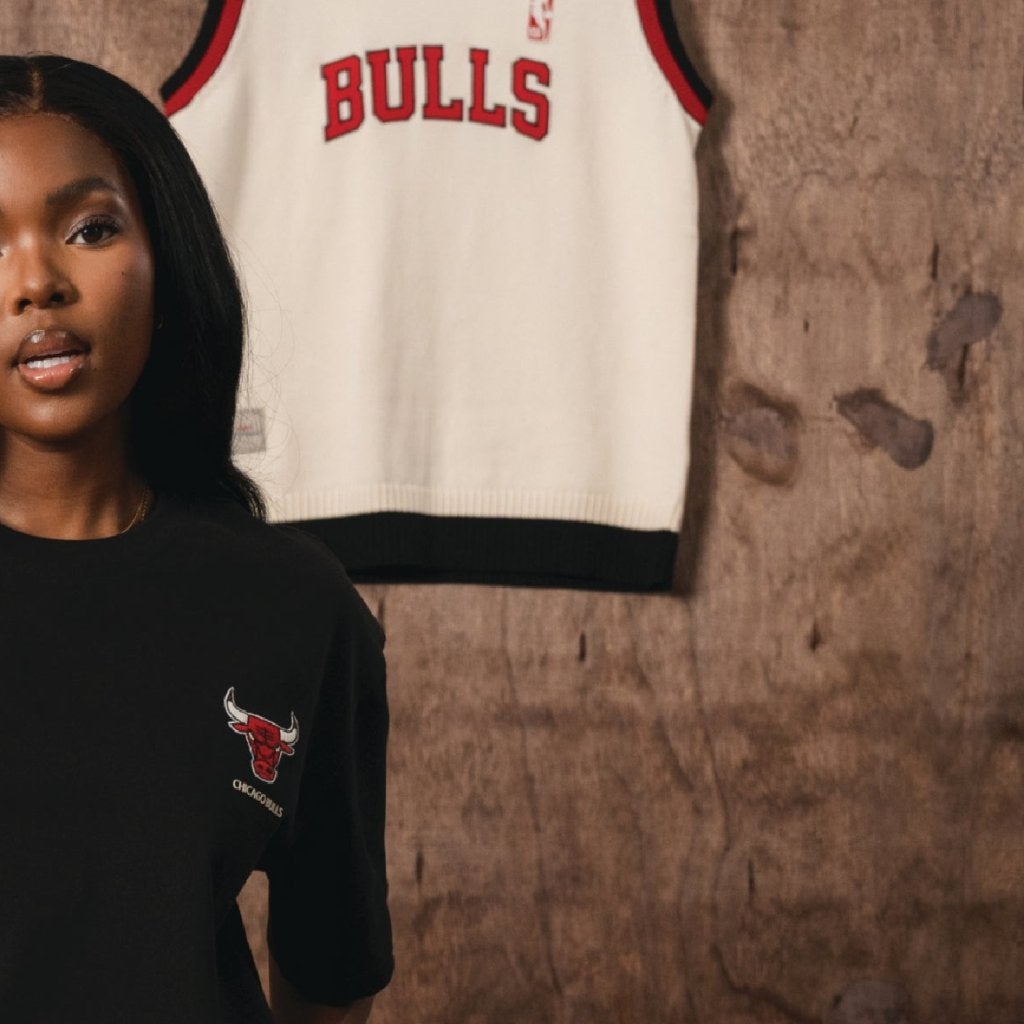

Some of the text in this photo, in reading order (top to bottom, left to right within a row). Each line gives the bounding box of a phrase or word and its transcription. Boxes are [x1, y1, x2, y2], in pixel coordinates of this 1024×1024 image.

[320, 44, 550, 142] BULLS
[232, 779, 283, 818] CHICAGO BULLS
